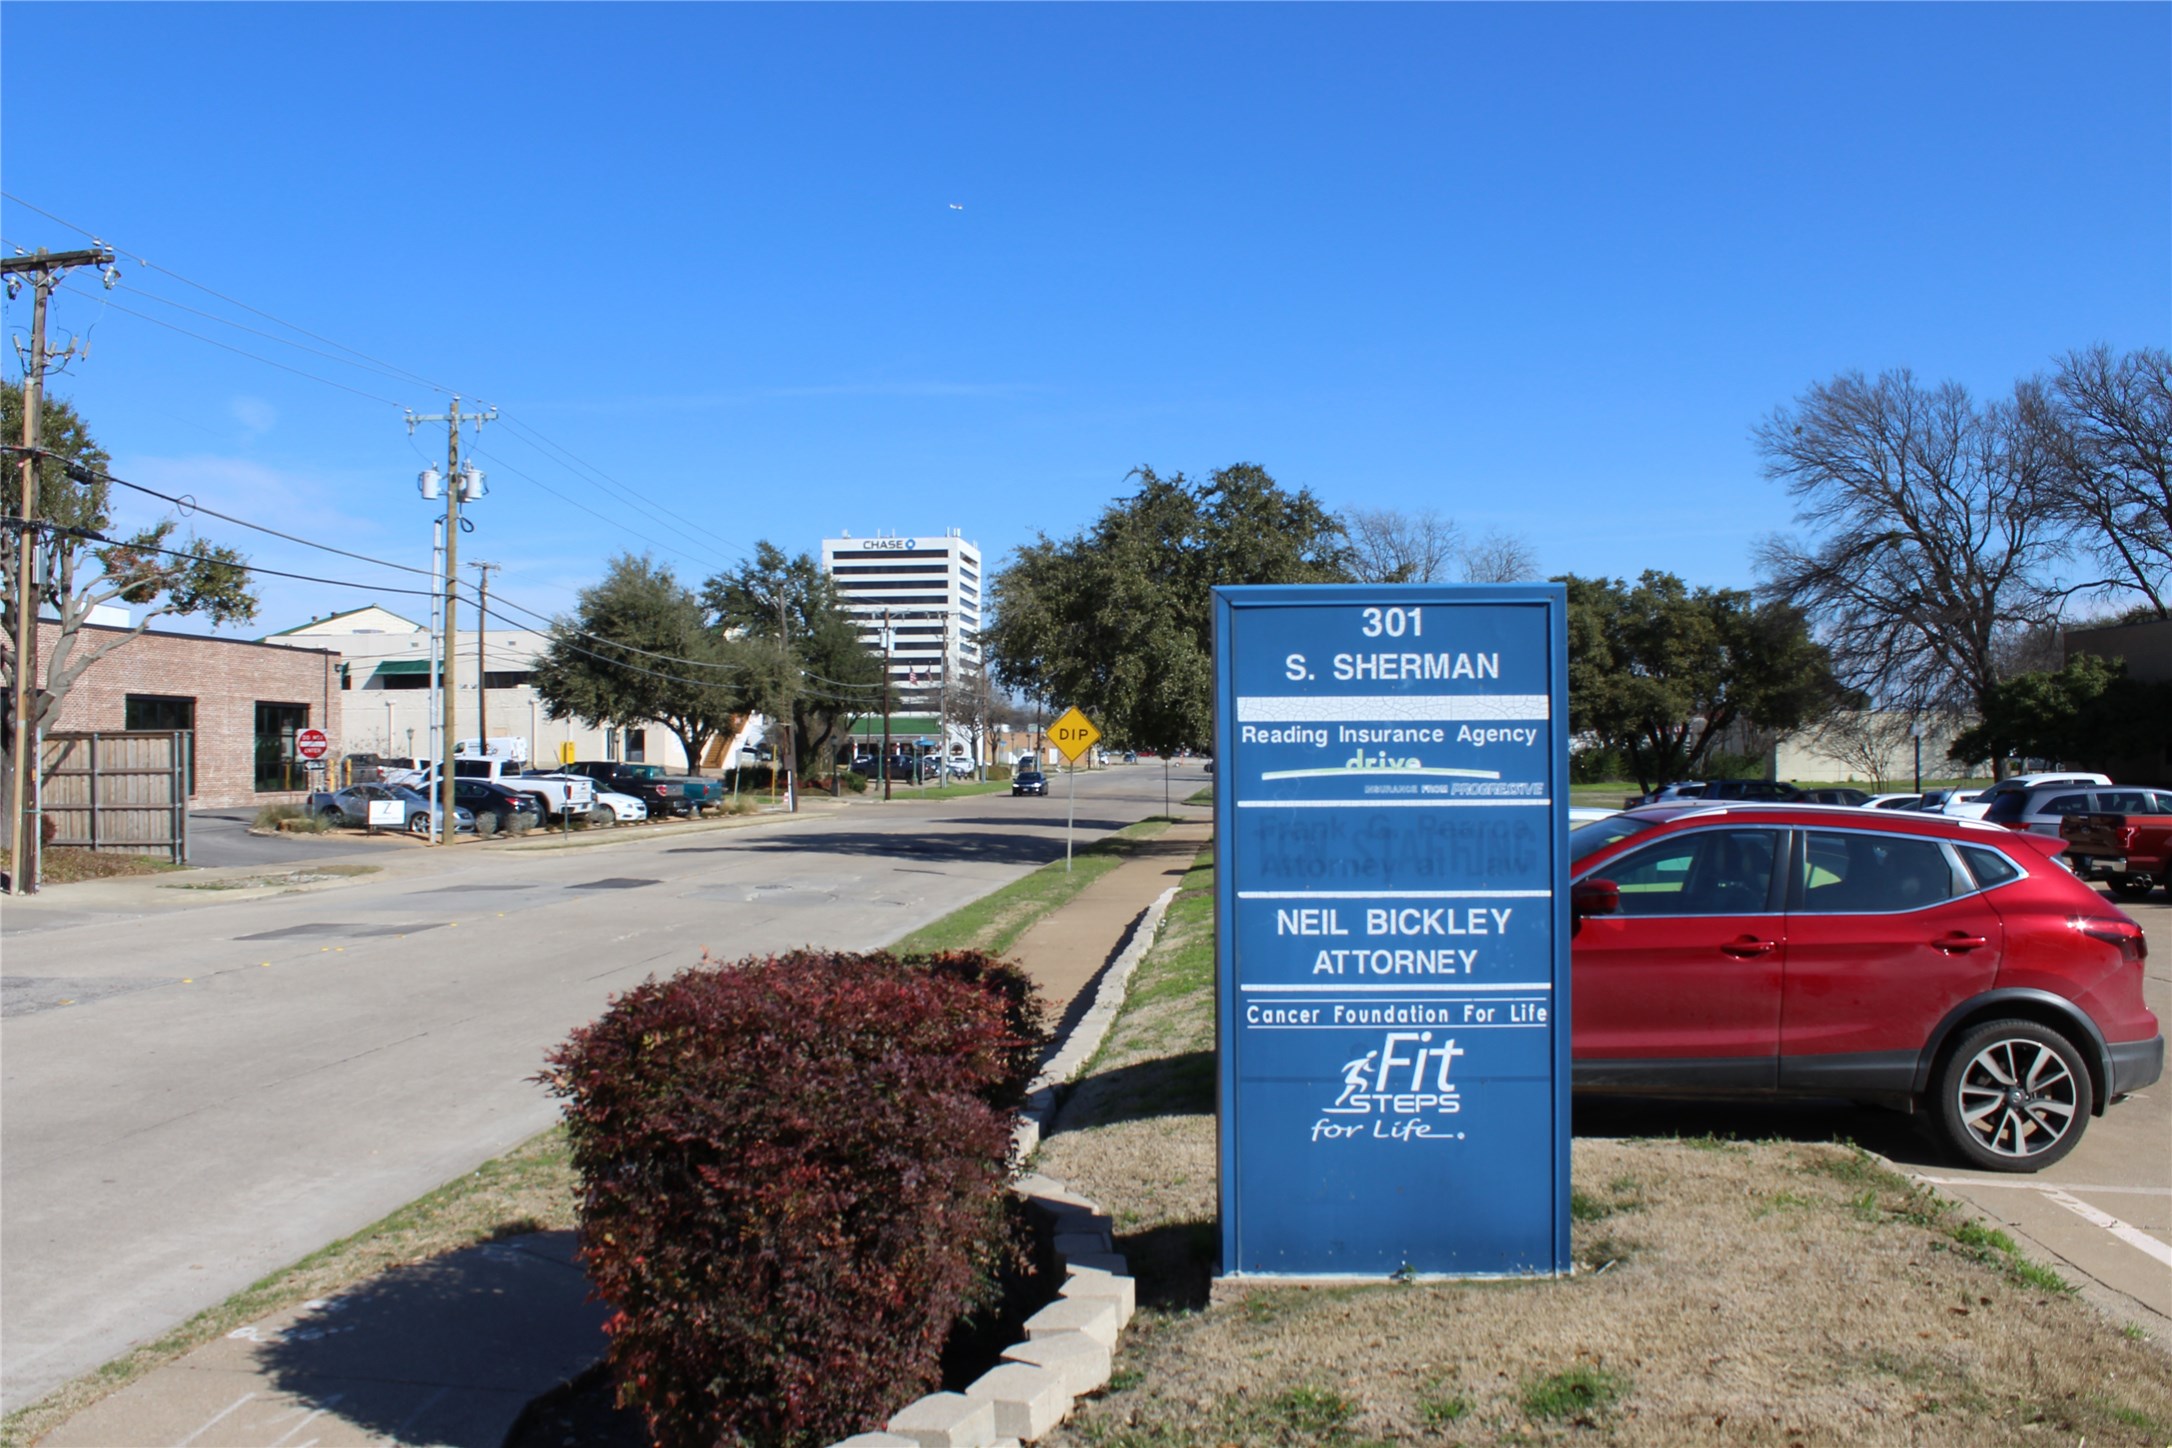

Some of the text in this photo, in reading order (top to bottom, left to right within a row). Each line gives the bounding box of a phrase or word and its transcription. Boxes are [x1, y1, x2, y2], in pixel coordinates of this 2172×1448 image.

[863, 540, 904, 549] CHASE
[1361, 607, 1423, 637] 301
[1285, 652, 1500, 681] S. SHERMAN
[1059, 728, 1088, 740] DIP
[1241, 725, 1537, 747] Reading Insurance Agency
[1345, 748, 1422, 768] drive
[1421, 784, 1448, 794] FROM
[1450, 782, 1545, 795] PROGRESSIVE
[1277, 908, 1512, 935] NEIL BICKLEY
[1312, 950, 1478, 974] ATTORNEY
[1247, 1003, 1548, 1024] Cancer Foundation For Life
[1375, 1031, 1464, 1092] Fit
[1350, 1094, 1460, 1113] STEPS
[1311, 1118, 1363, 1142] for
